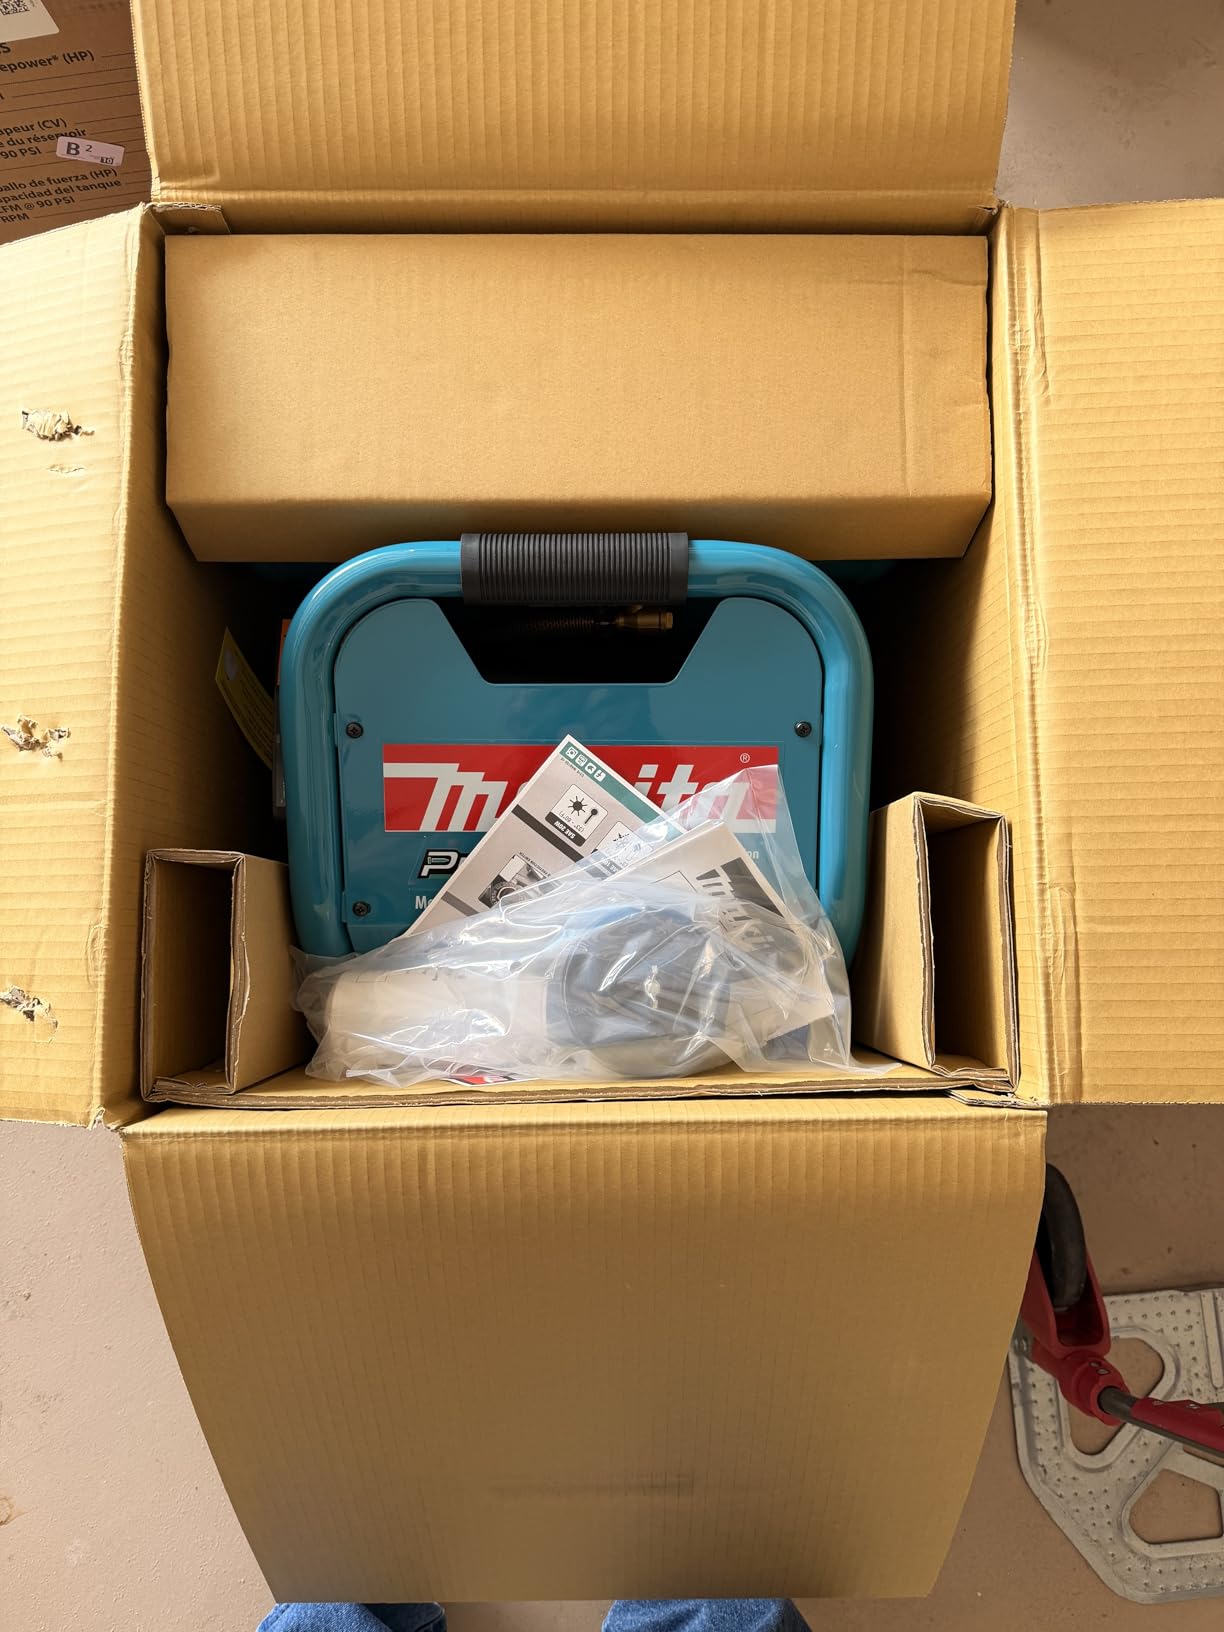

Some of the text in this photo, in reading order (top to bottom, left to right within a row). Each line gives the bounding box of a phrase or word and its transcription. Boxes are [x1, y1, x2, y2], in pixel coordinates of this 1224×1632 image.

[63, 49, 94, 64] (HP)
[37, 118, 67, 131] (CV)
[7, 138, 24, 147] du
[66, 142, 80, 155] B
[86, 144, 93, 152] 2
[1, 146, 42, 159] 90 PSI
[29, 179, 46, 188] de
[48, 173, 88, 185] fuerza
[90, 168, 118, 179] (HP)
[55, 184, 75, 194] del
[76, 180, 121, 194] tanque
[36, 200, 53, 208] 90
[55, 195, 75, 206] PSI
[1, 212, 30, 223] RPM
[383, 763, 776, 832] Mita
[565, 827, 576, 839] SAE
